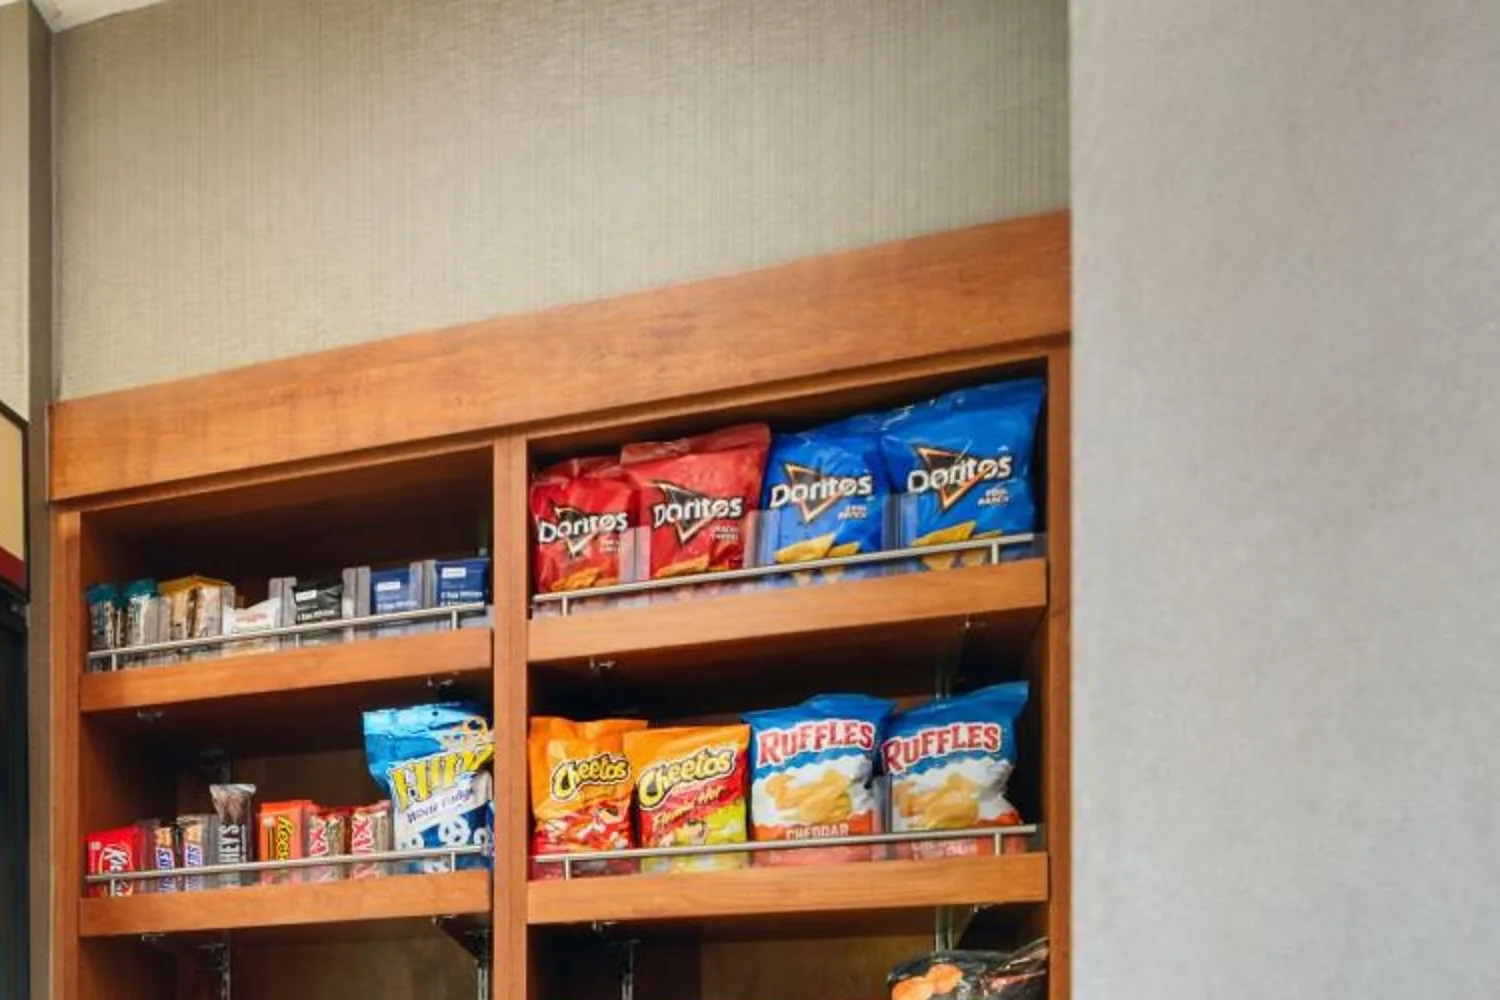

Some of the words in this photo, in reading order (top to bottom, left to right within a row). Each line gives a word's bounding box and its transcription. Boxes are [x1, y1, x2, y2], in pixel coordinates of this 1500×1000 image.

[770, 473, 873, 510] Doritos
[907, 454, 1012, 494] Doritos
[538, 511, 629, 543] Doritos
[652, 496, 743, 529] Doritos
[757, 720, 875, 766] RUFFLES
[882, 723, 1001, 772] RUFFLES
[552, 752, 630, 800] Cheetos
[638, 748, 735, 808] Cheetos
[276, 816, 295, 862] Rees
